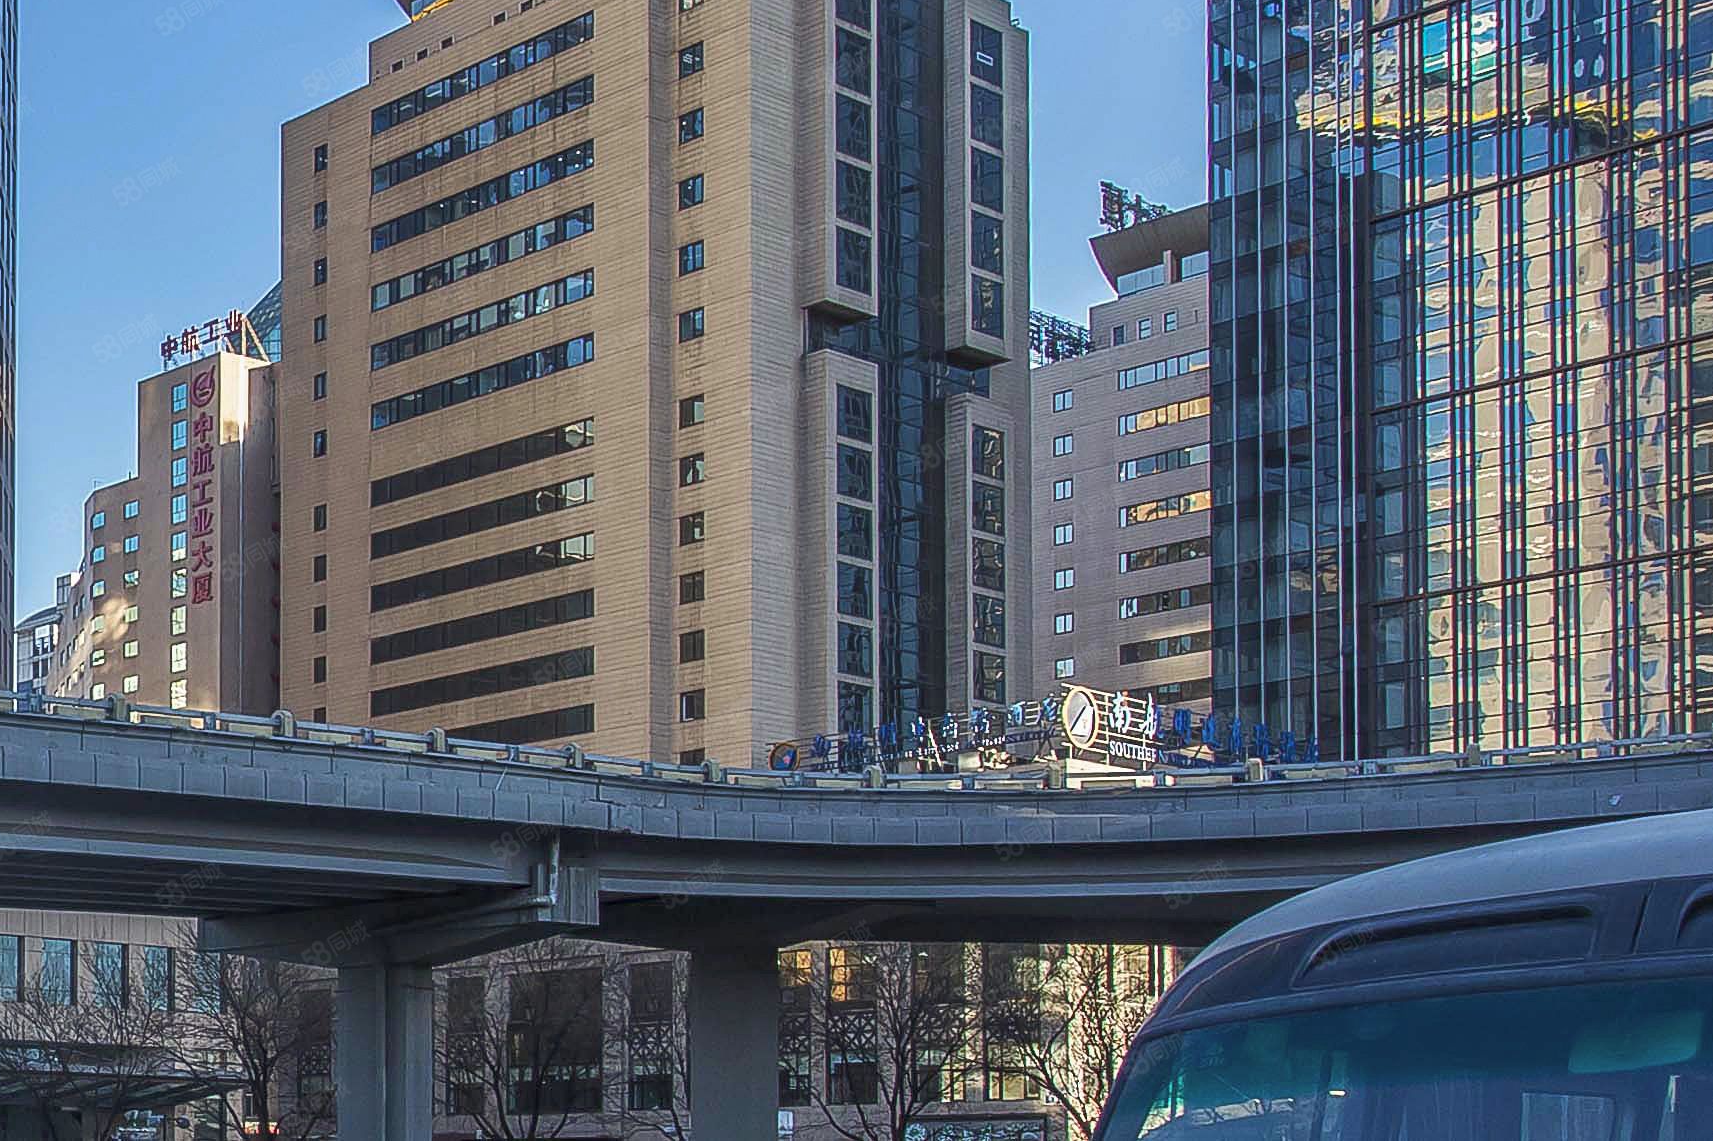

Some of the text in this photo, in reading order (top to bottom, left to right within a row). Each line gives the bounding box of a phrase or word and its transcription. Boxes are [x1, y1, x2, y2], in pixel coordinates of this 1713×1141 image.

[160, 309, 244, 361] 中航工业
[192, 412, 215, 605] 中航工业大厦
